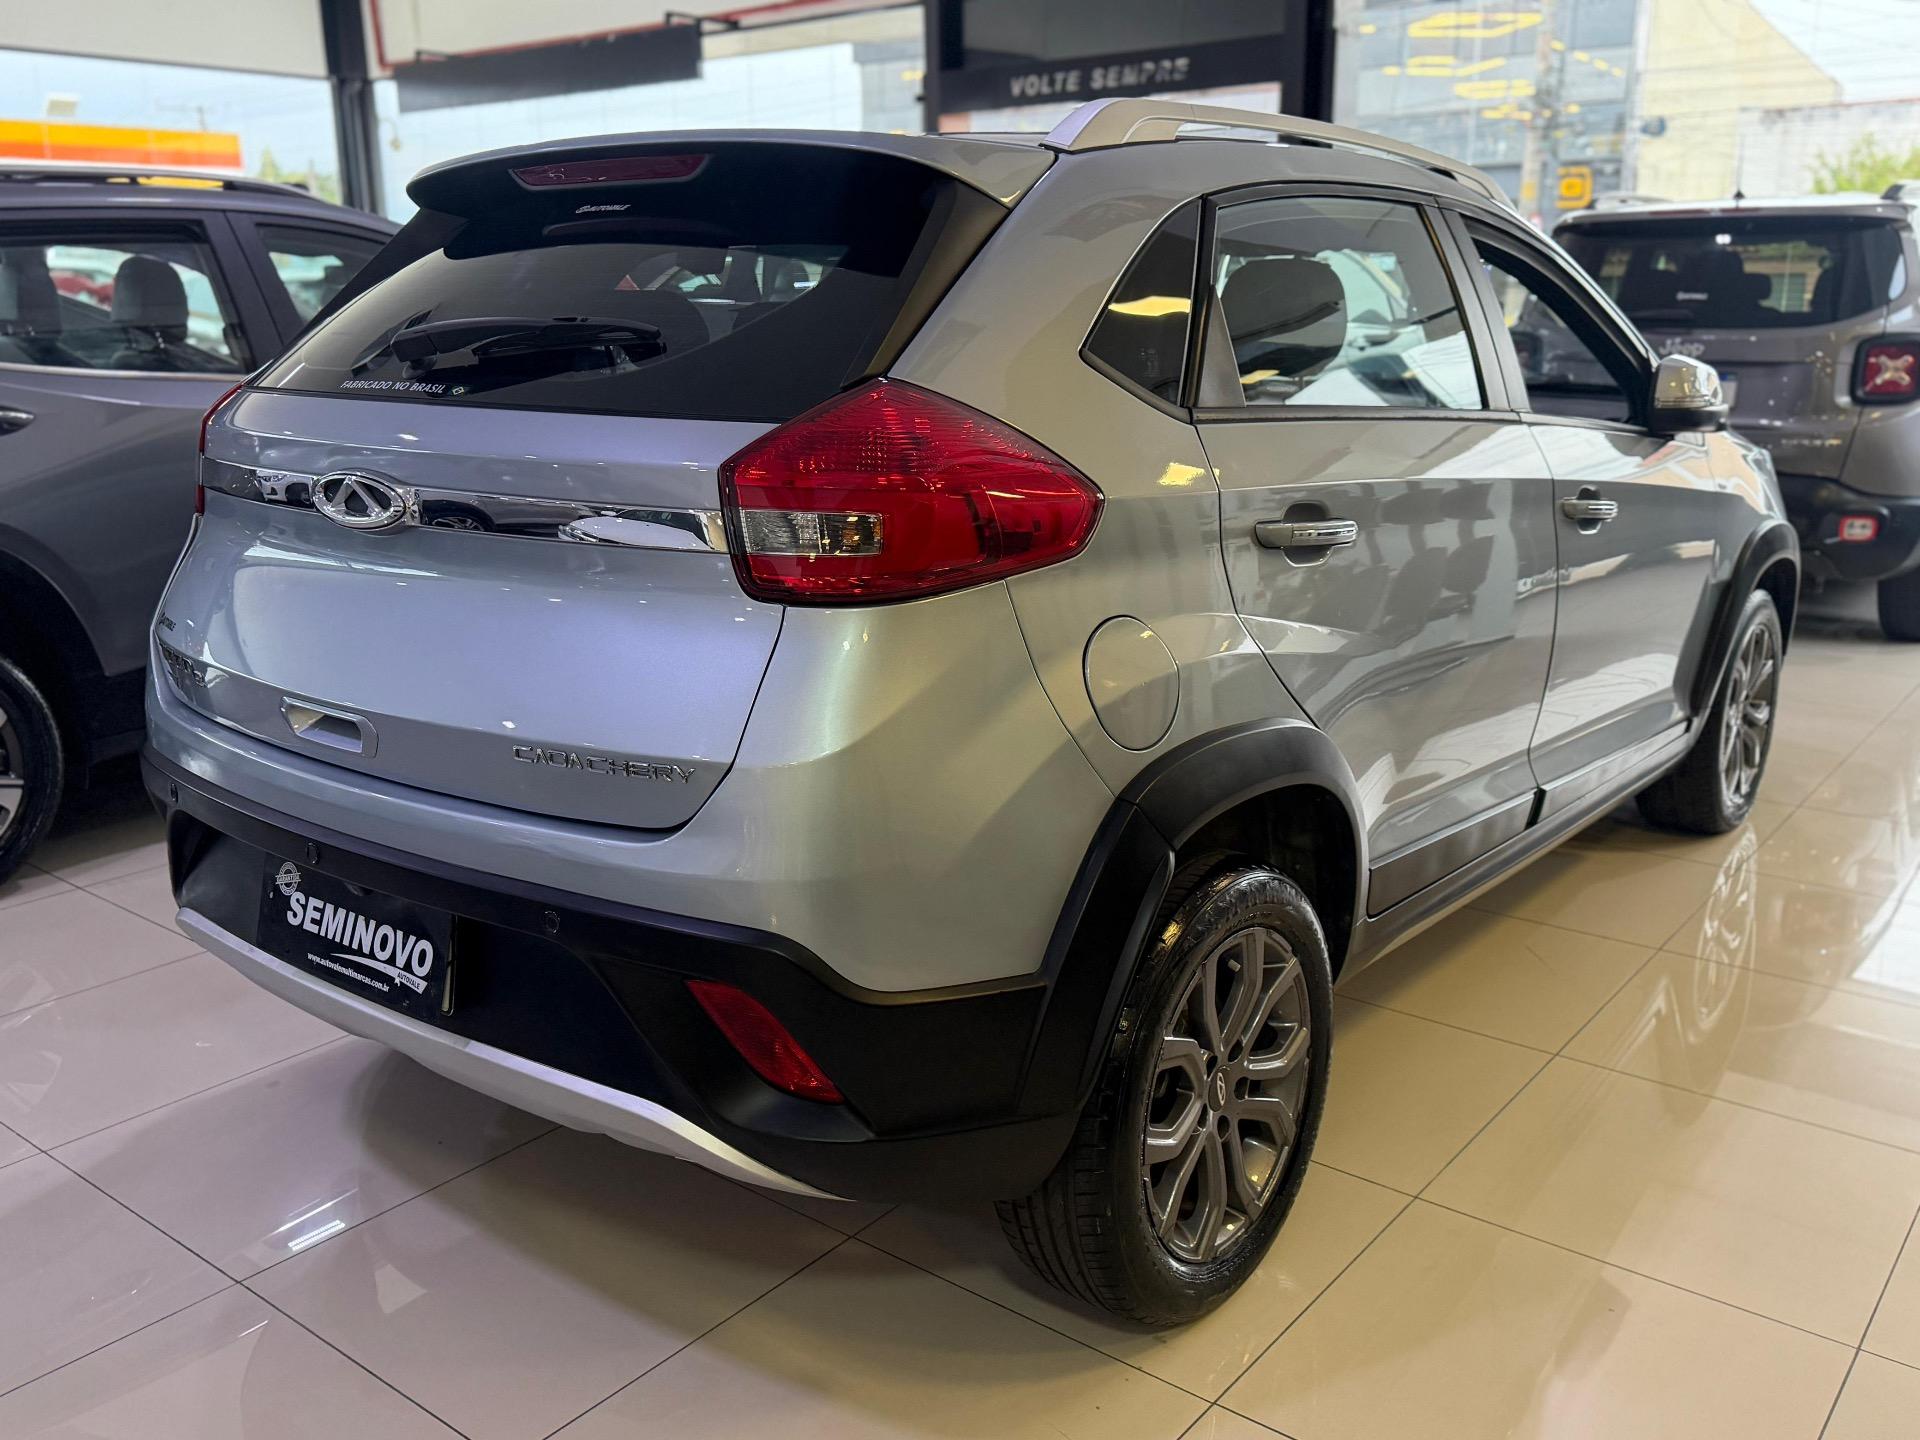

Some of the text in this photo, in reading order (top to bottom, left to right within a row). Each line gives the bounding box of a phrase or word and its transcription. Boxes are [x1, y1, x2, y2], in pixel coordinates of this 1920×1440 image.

[1010, 57, 1190, 98] VOLTE SEMPRE
[340, 380, 446, 394] FABRICADO NO BRASIL
[586, 756, 696, 784] CHERY
[286, 891, 434, 977] SEMINOVO
[397, 971, 421, 990] AUTOVALE
